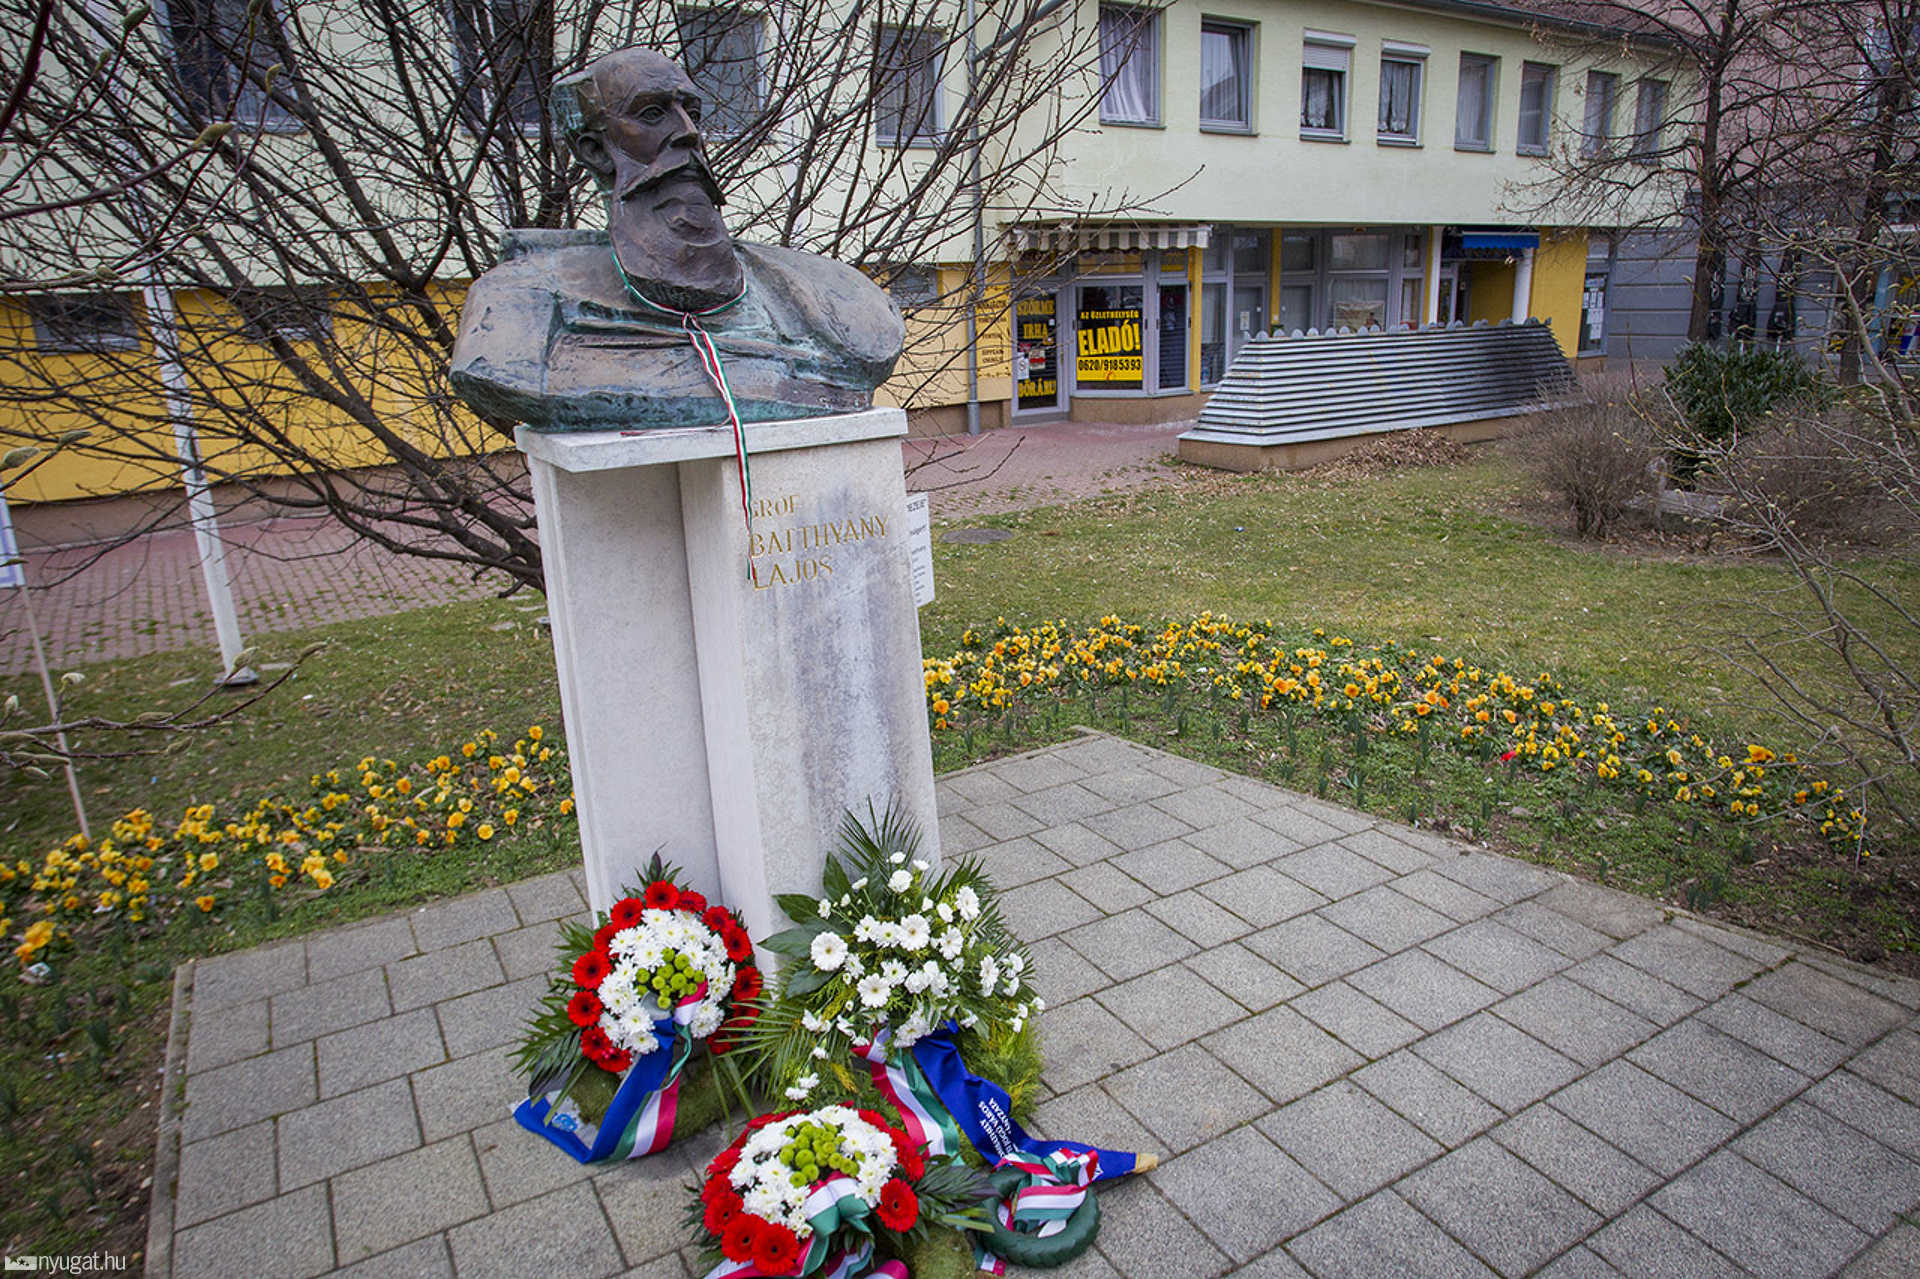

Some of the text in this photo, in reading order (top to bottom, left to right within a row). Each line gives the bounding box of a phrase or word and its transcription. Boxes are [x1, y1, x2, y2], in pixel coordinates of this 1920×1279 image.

[1078, 319, 1140, 356] ELADÓ!
[751, 511, 889, 558] BATTHYÁNY
[754, 554, 833, 591] LAJOS
